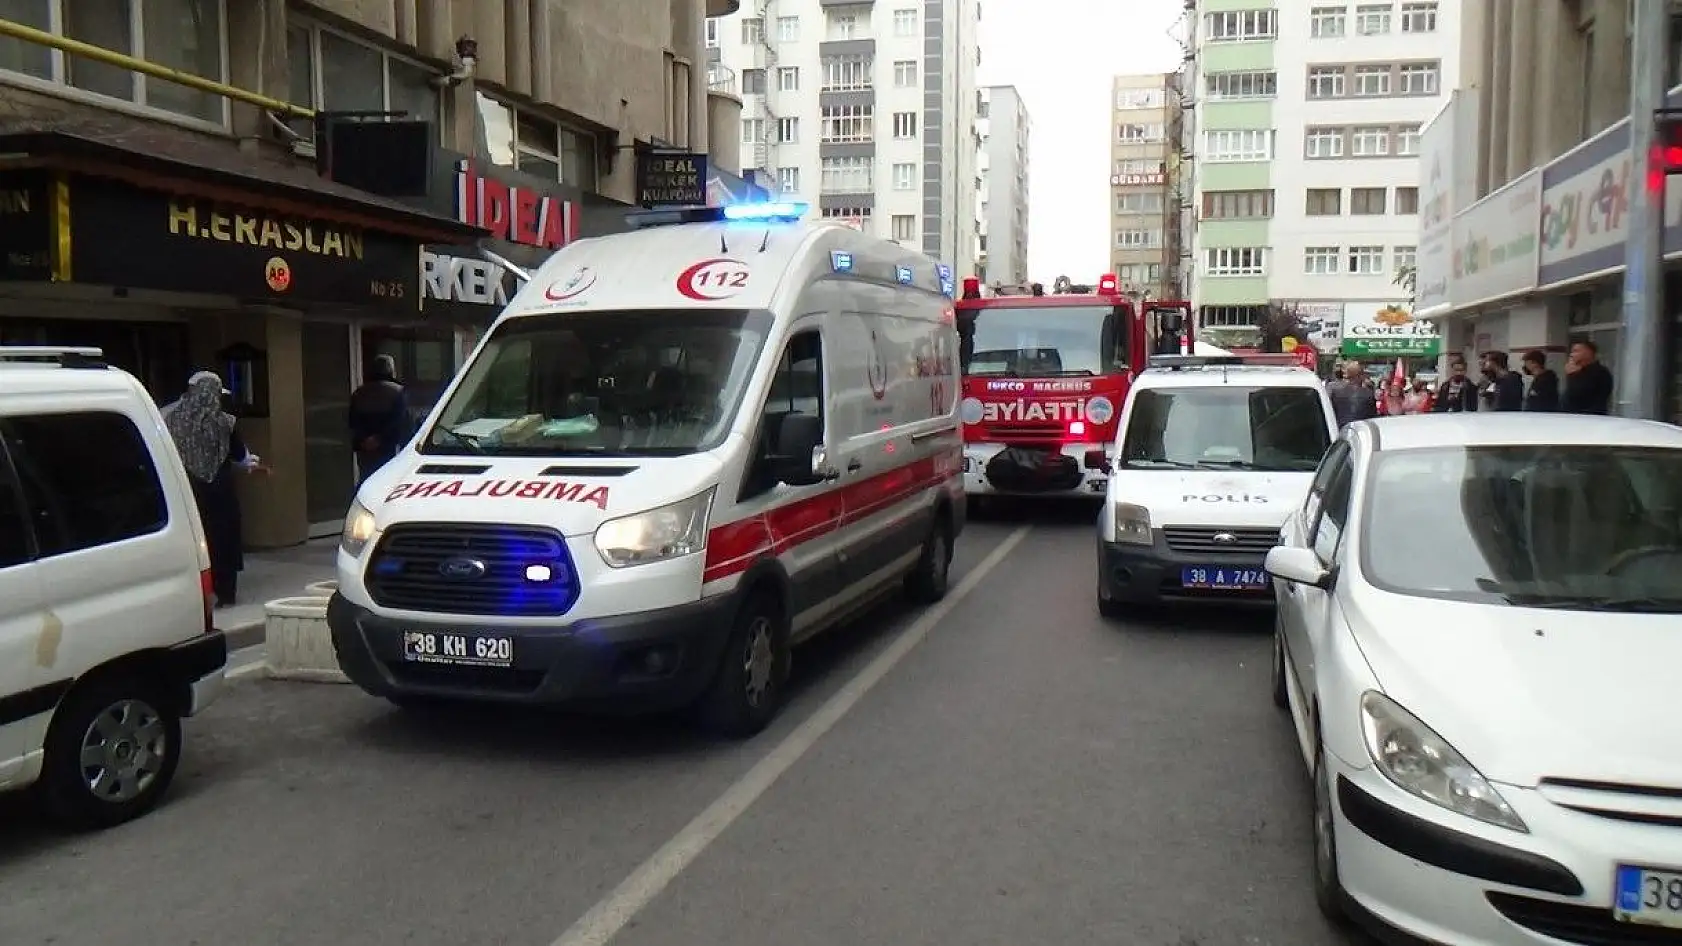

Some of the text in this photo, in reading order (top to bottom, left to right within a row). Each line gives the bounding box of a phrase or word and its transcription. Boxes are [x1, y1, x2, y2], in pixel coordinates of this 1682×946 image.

[697, 270, 750, 289] 112
[1190, 568, 1265, 585] 38 A 7474
[415, 633, 510, 659] 38 KH 620
[1643, 875, 1682, 911] 38
